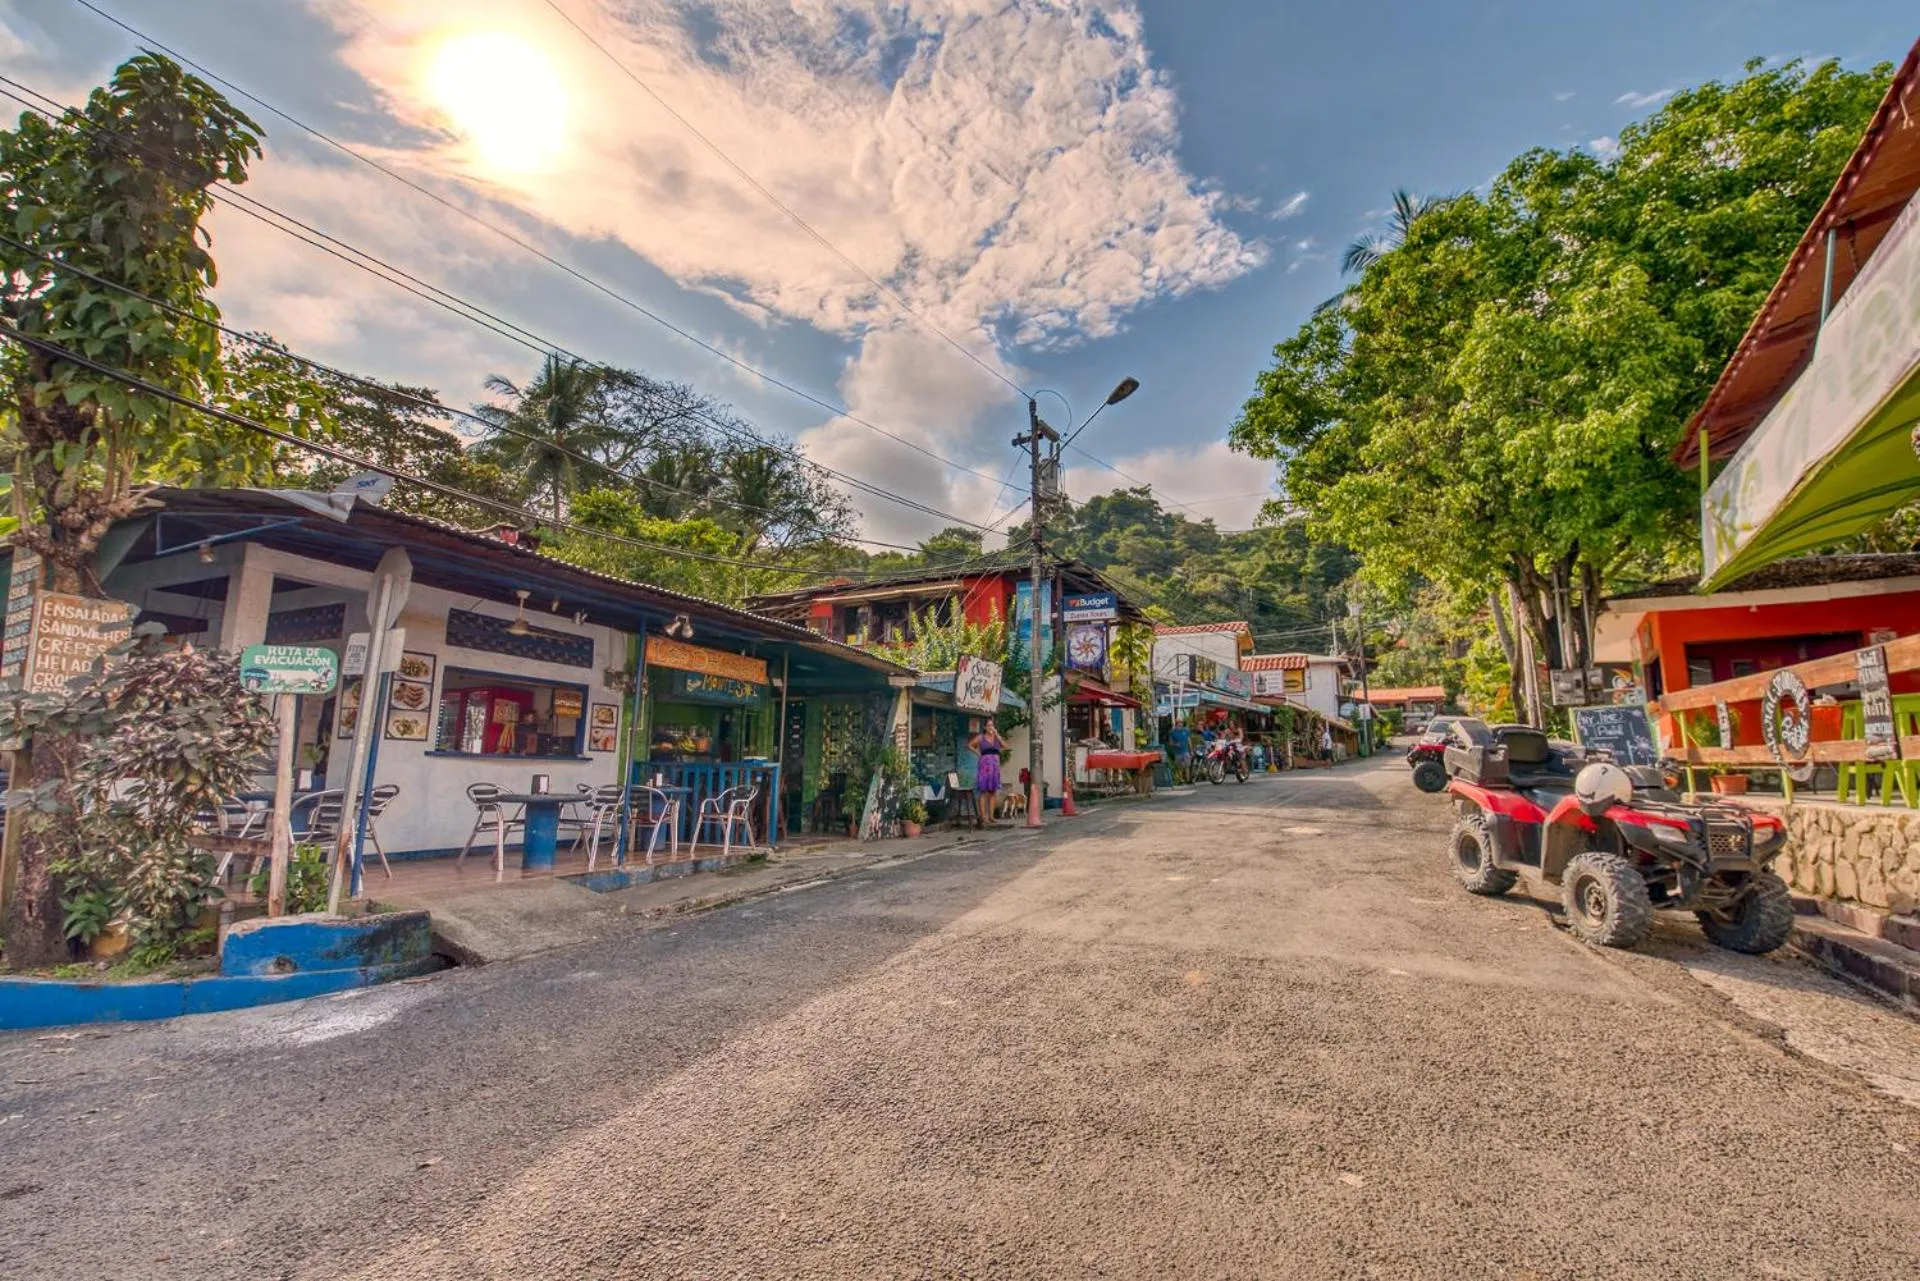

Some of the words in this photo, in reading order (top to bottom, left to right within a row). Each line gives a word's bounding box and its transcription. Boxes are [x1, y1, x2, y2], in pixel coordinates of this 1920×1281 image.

[1080, 597, 1108, 608] Budget
[268, 646, 301, 656] RUTA
[306, 647, 319, 657] DE
[35, 654, 115, 673] HELADS
